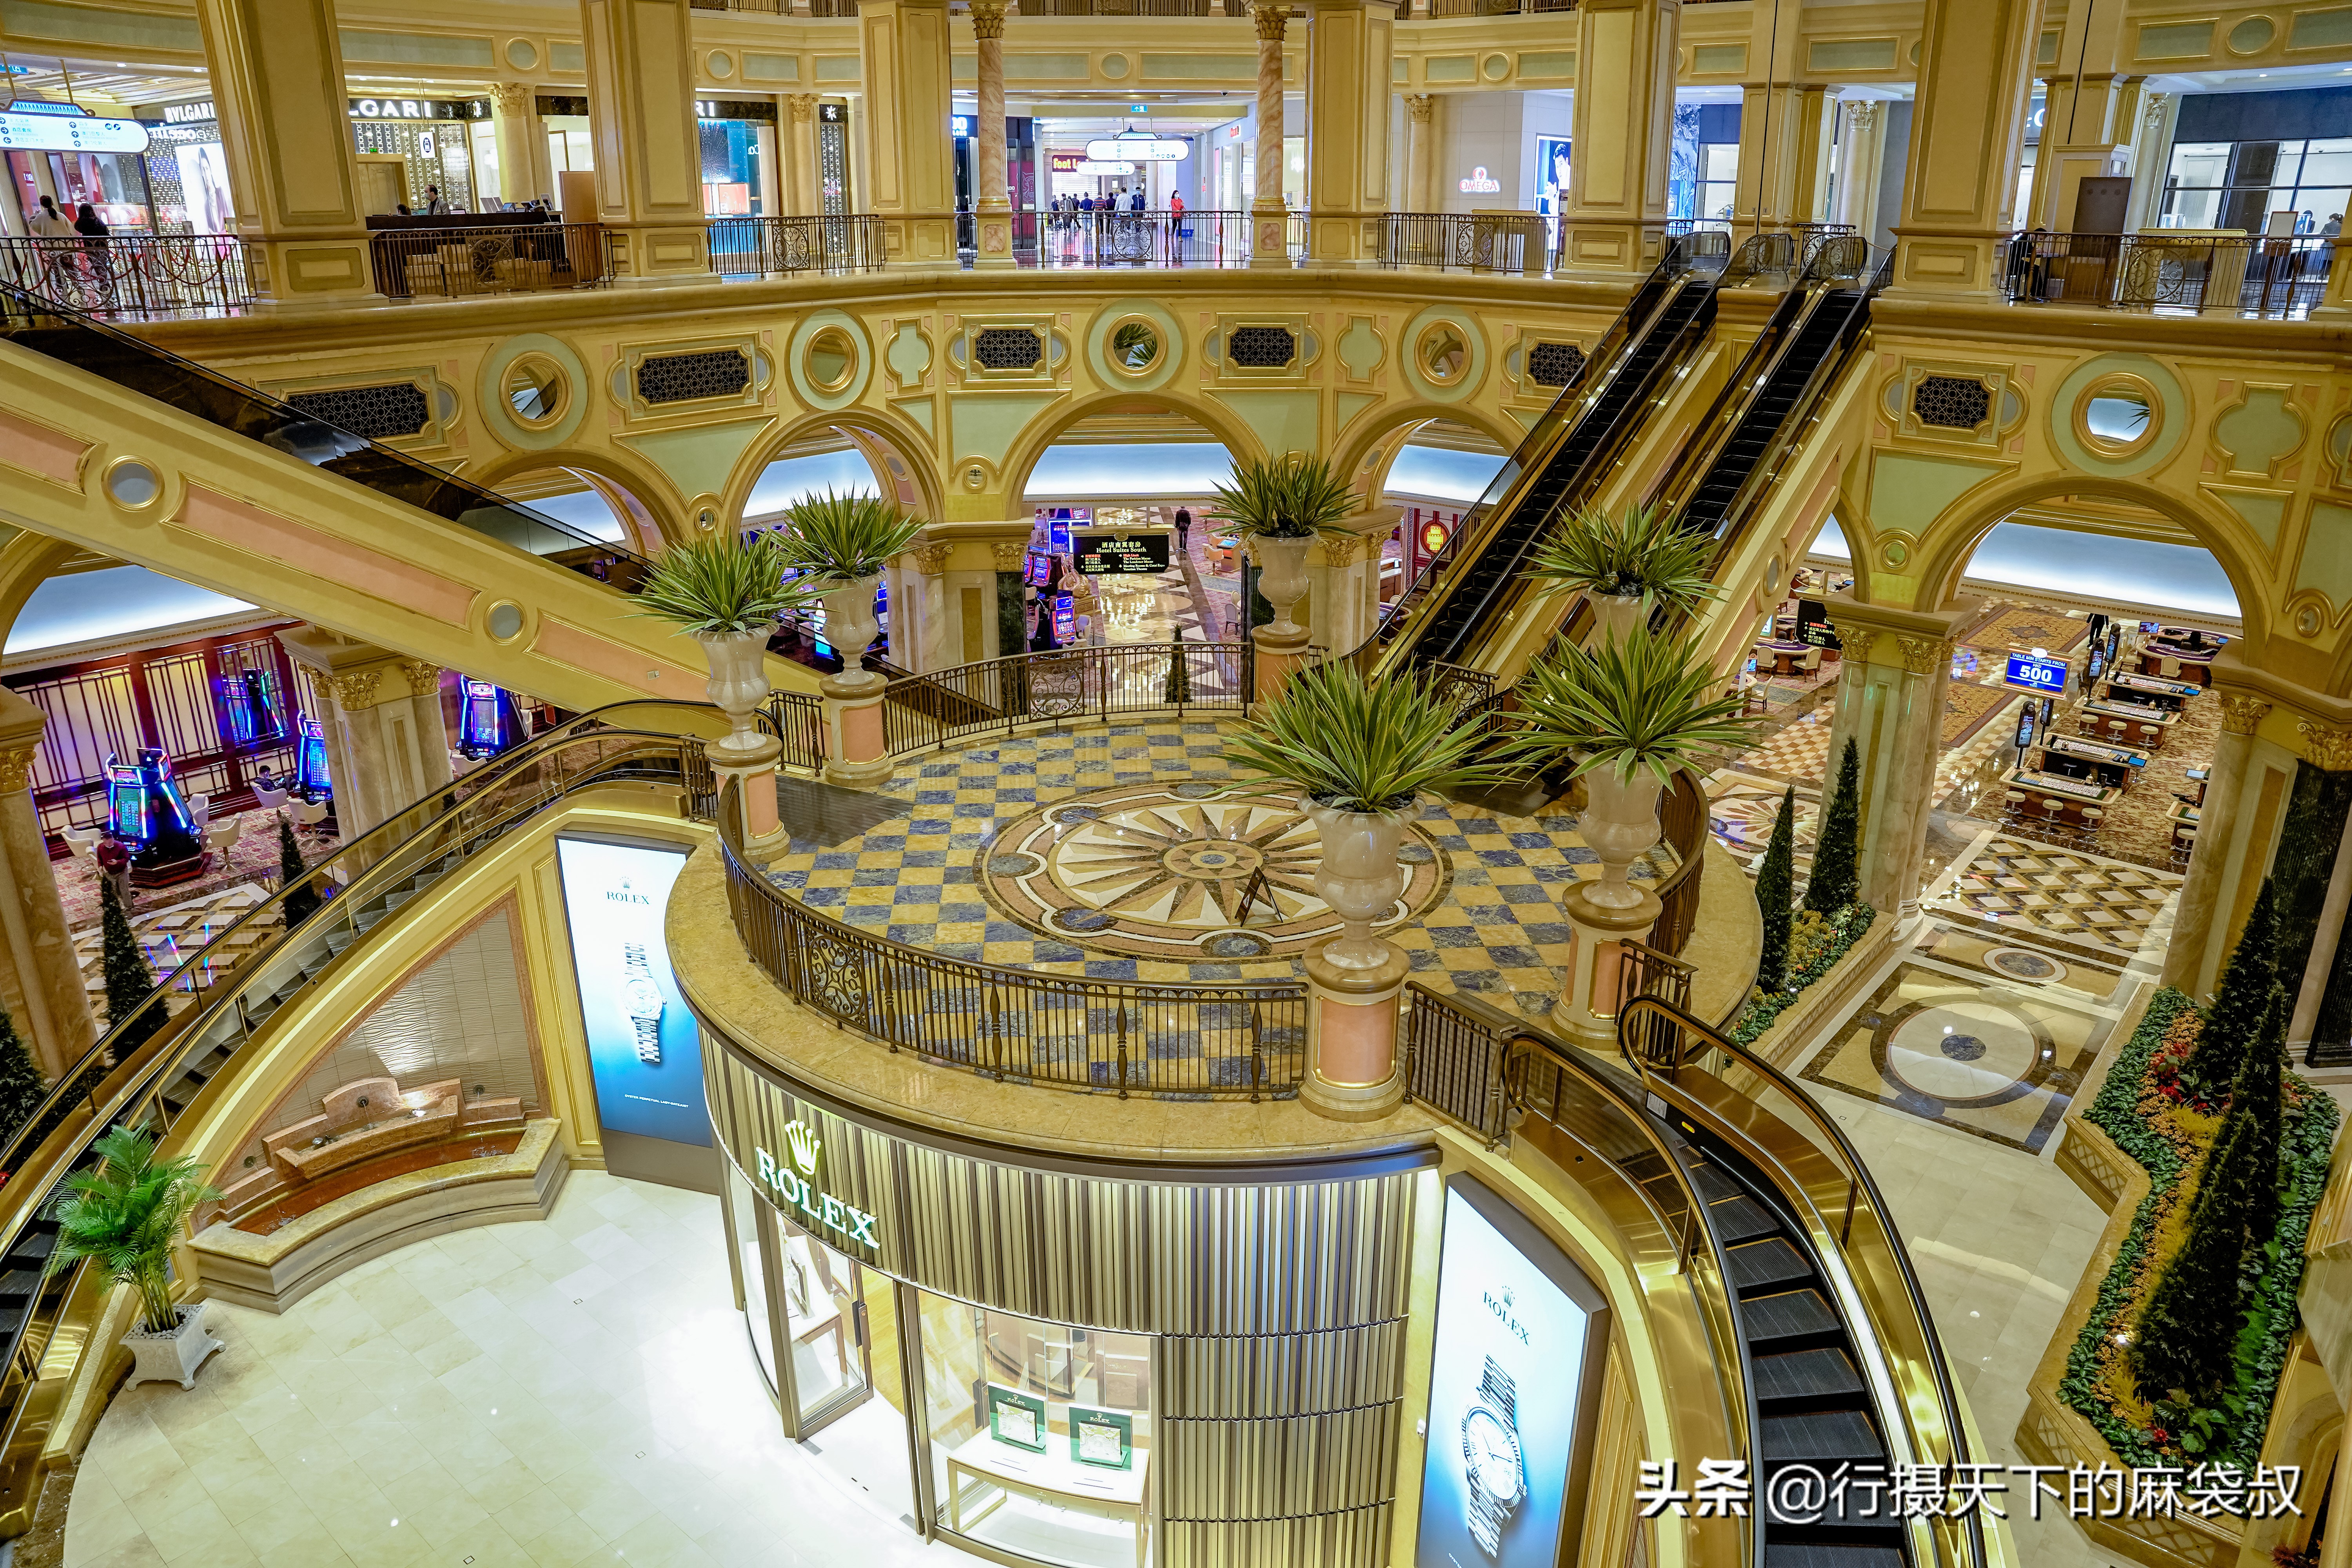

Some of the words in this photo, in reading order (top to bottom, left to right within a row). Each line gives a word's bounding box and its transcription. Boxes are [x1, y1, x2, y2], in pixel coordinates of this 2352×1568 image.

[164, 102, 216, 123] BVLGARI
[1459, 181, 1498, 191] OMEGA
[2019, 665, 2052, 682] 500
[606, 891, 650, 905] ROLEX
[755, 1146, 880, 1250] ROLEX
[1483, 1290, 1529, 1347] ROLEX
[1007, 1397, 1025, 1406] ROLEX
